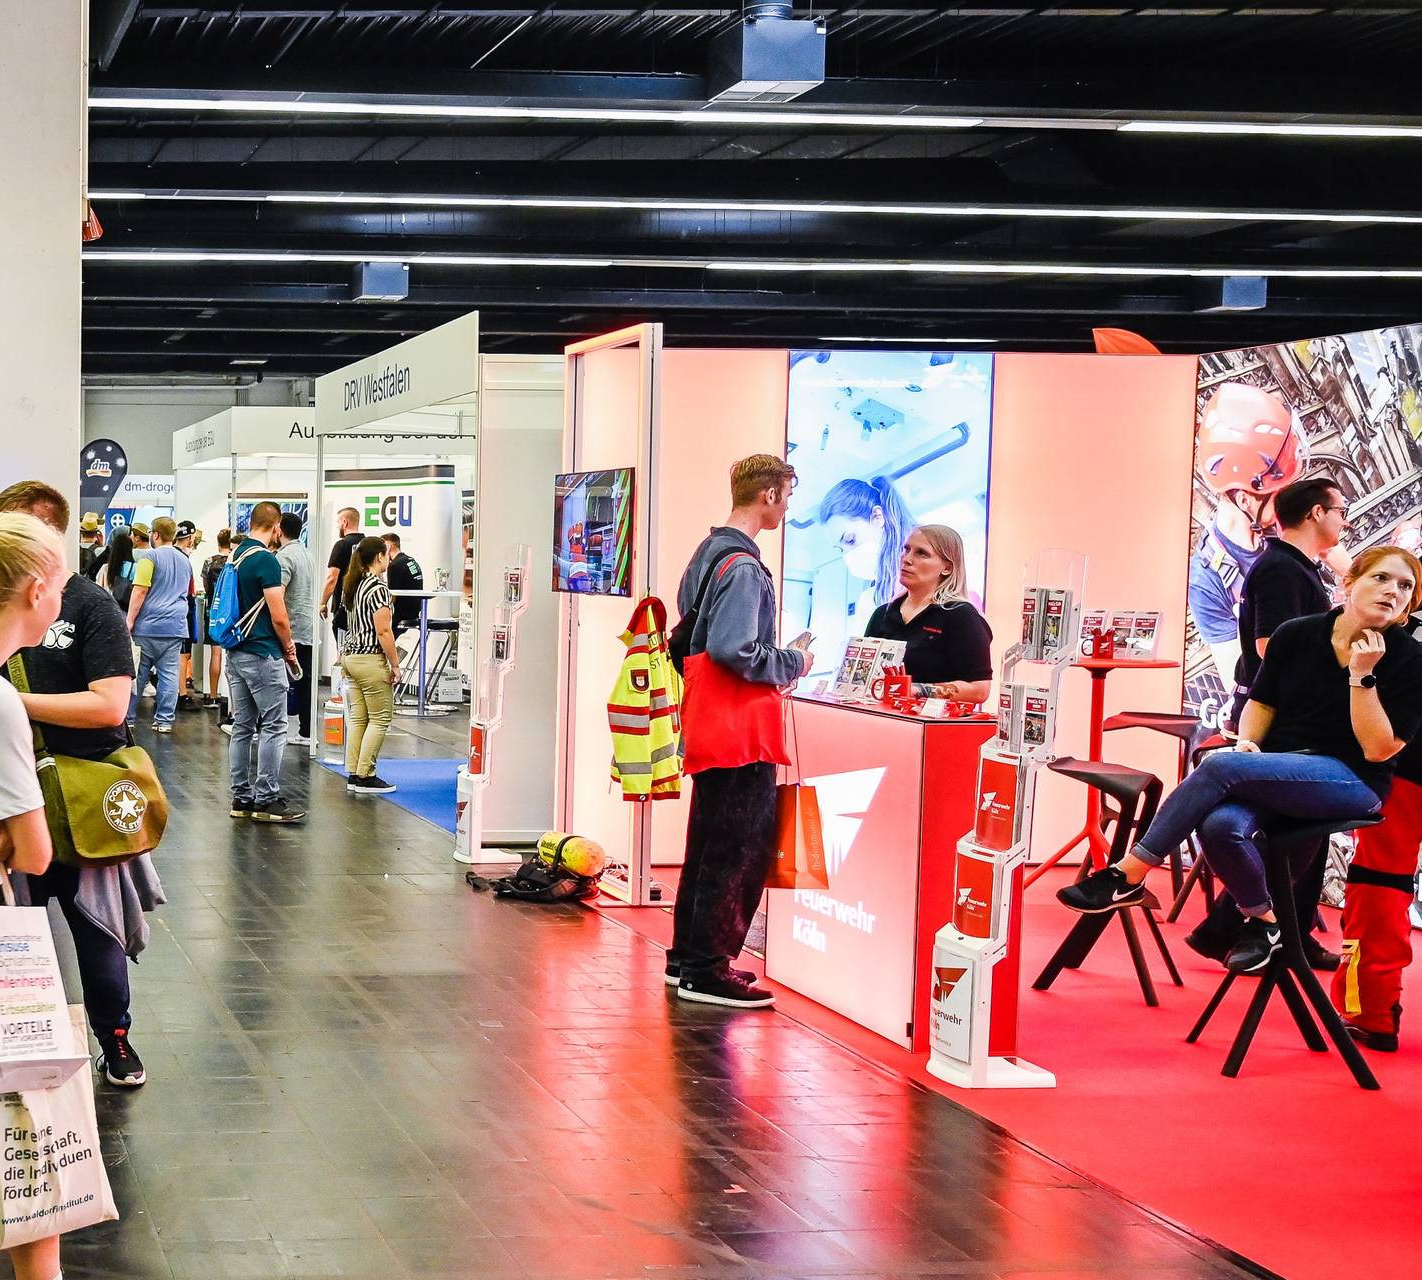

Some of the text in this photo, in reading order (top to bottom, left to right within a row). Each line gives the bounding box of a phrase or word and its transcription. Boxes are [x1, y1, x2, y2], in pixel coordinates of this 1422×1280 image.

[344, 363, 410, 411] DRV Westfalen
[92, 459, 109, 470] dm
[365, 496, 412, 527] EGU
[109, 784, 140, 802] CONVERSE
[114, 818, 128, 829] ALL
[792, 915, 827, 952] Köln
[0, 1020, 53, 1035] VORTEILE
[4, 1127, 28, 1142] Für
[4, 1167, 25, 1181] die
